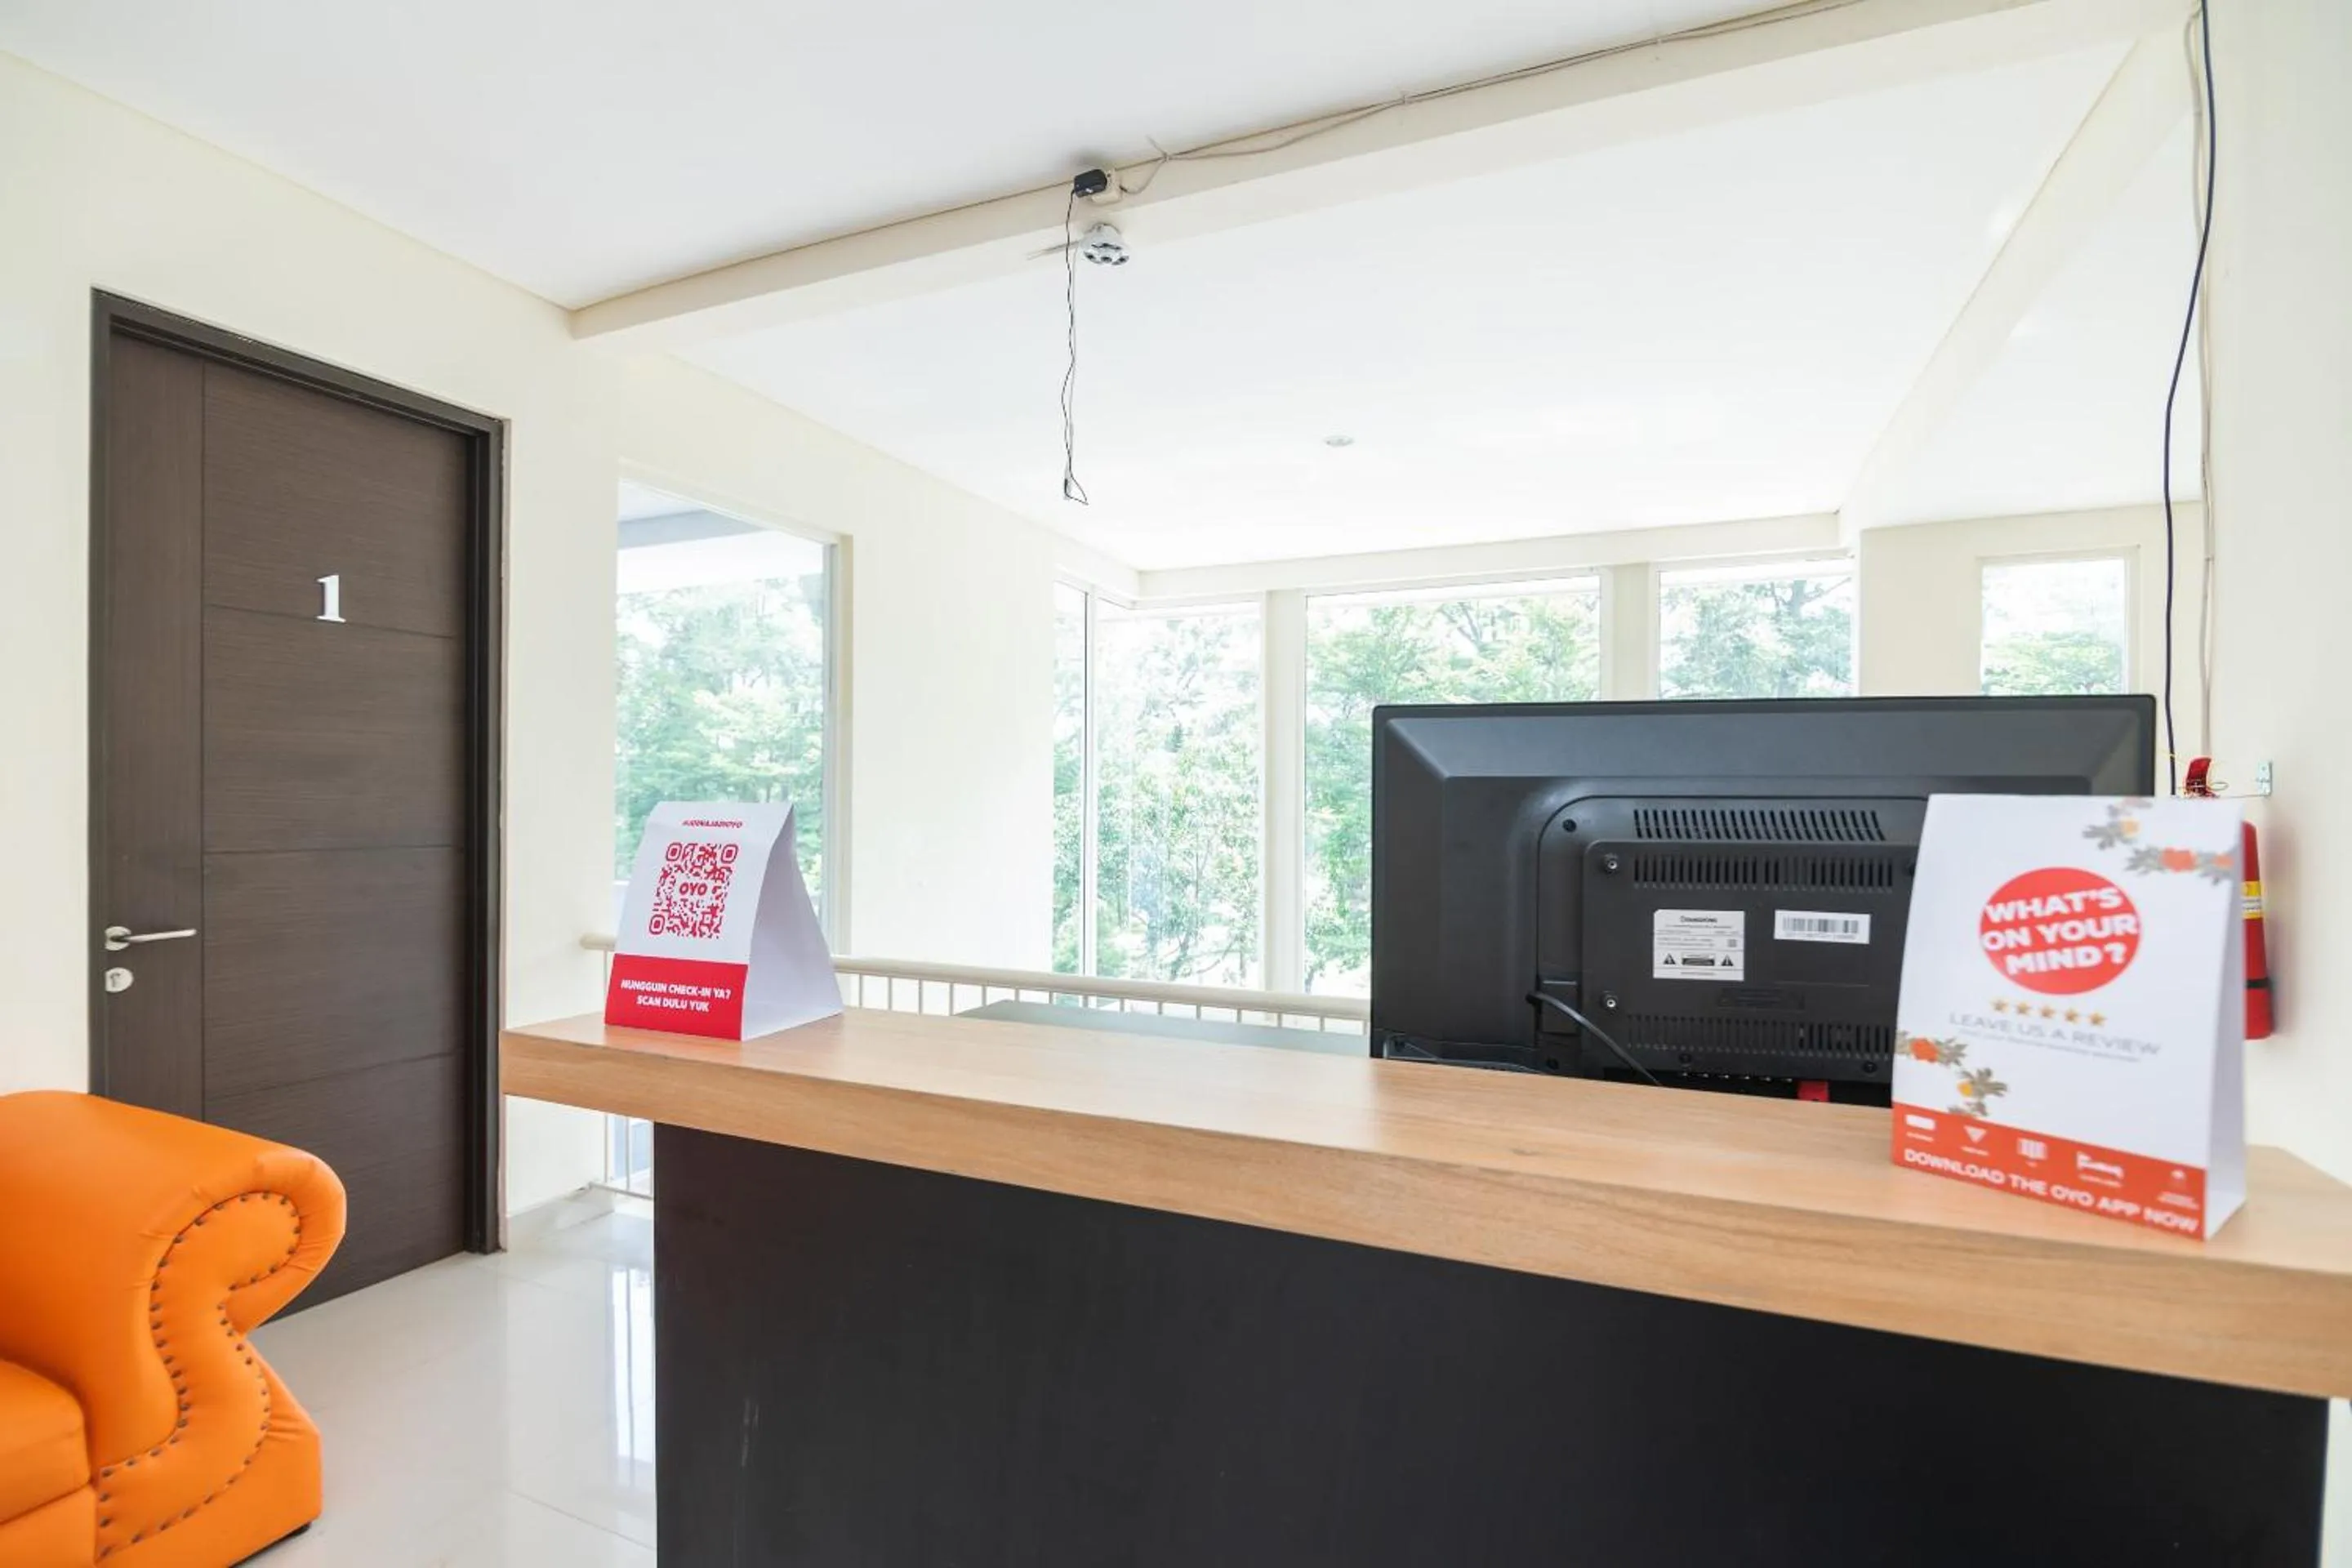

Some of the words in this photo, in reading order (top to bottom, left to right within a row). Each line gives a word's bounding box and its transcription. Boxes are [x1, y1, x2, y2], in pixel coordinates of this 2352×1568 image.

[317, 575, 346, 623] 1
[679, 882, 708, 896] OYO
[1985, 887, 2123, 923] WHAT'S
[1981, 926, 2032, 951] ON
[2037, 913, 2138, 944] YOUR
[637, 995, 662, 1008] SCAN
[662, 997, 687, 1009] DULU
[689, 1000, 710, 1013] YUK
[669, 983, 711, 997] CHECK-IN
[713, 987, 732, 1000] YA?
[1949, 1012, 2012, 1032] LEAVE
[2018, 1023, 2046, 1038] US
[2051, 1028, 2068, 1040] A
[2073, 1031, 2163, 1056] REVIEW
[1904, 1147, 2006, 1184] DOWNLOAD
[2008, 1173, 2048, 1196] THE
[2050, 1184, 2095, 1207] OYO
[2096, 1196, 2141, 1217] APP
[2143, 1205, 2199, 1232] NOW
